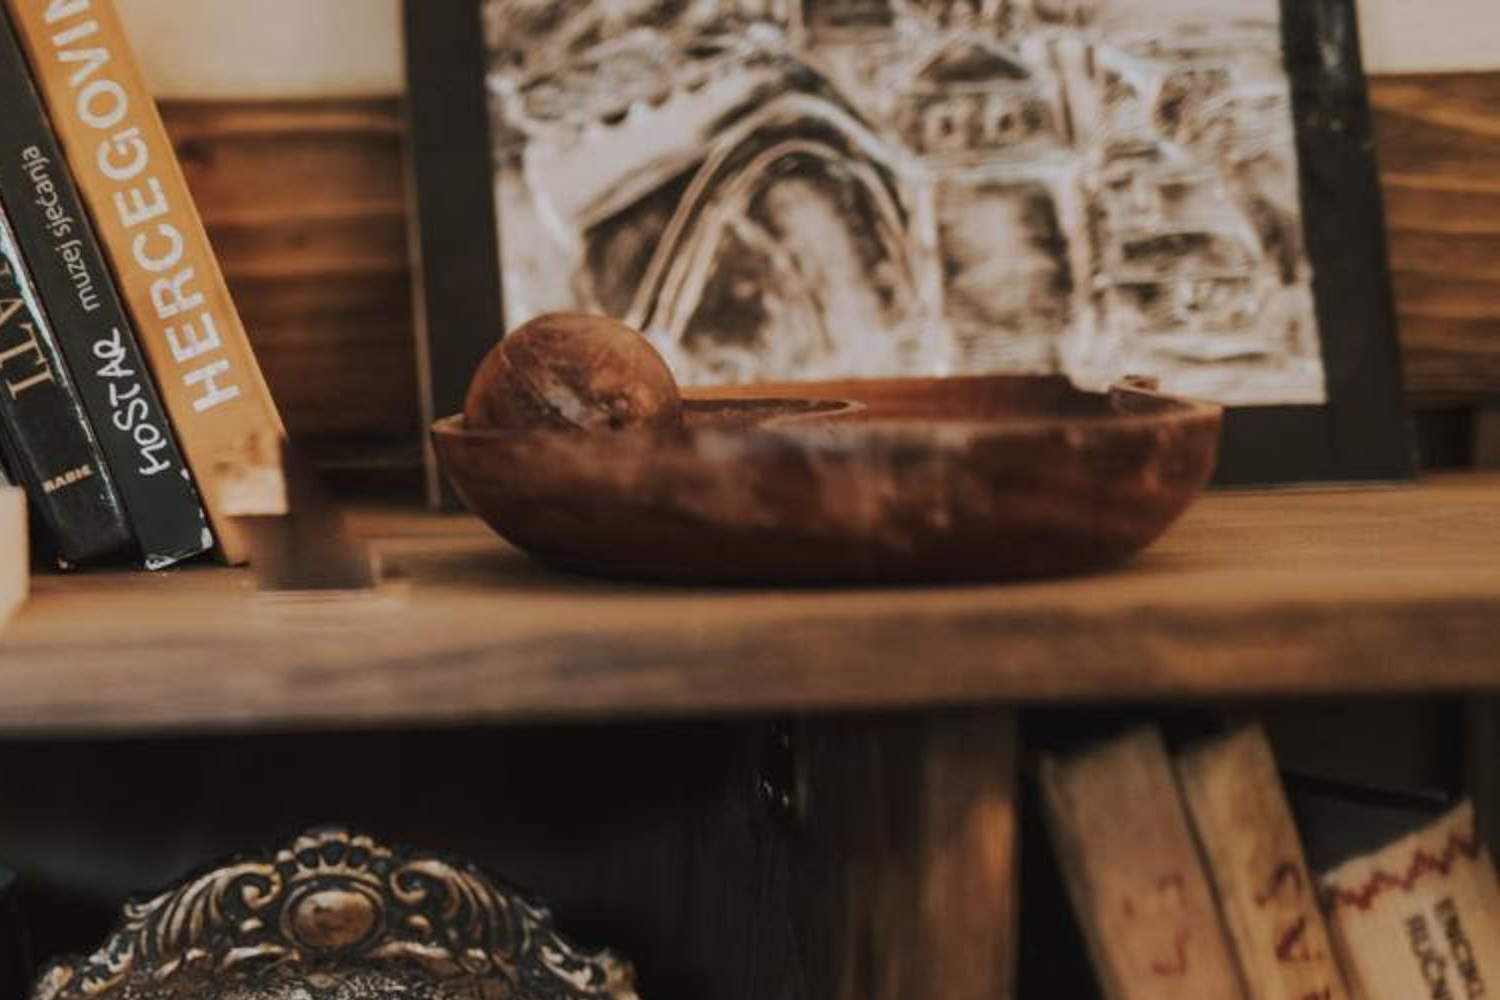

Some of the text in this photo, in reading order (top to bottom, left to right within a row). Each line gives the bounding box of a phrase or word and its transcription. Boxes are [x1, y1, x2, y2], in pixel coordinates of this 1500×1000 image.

[20, 145, 171, 476] MOSTAR muzej sjećanja
